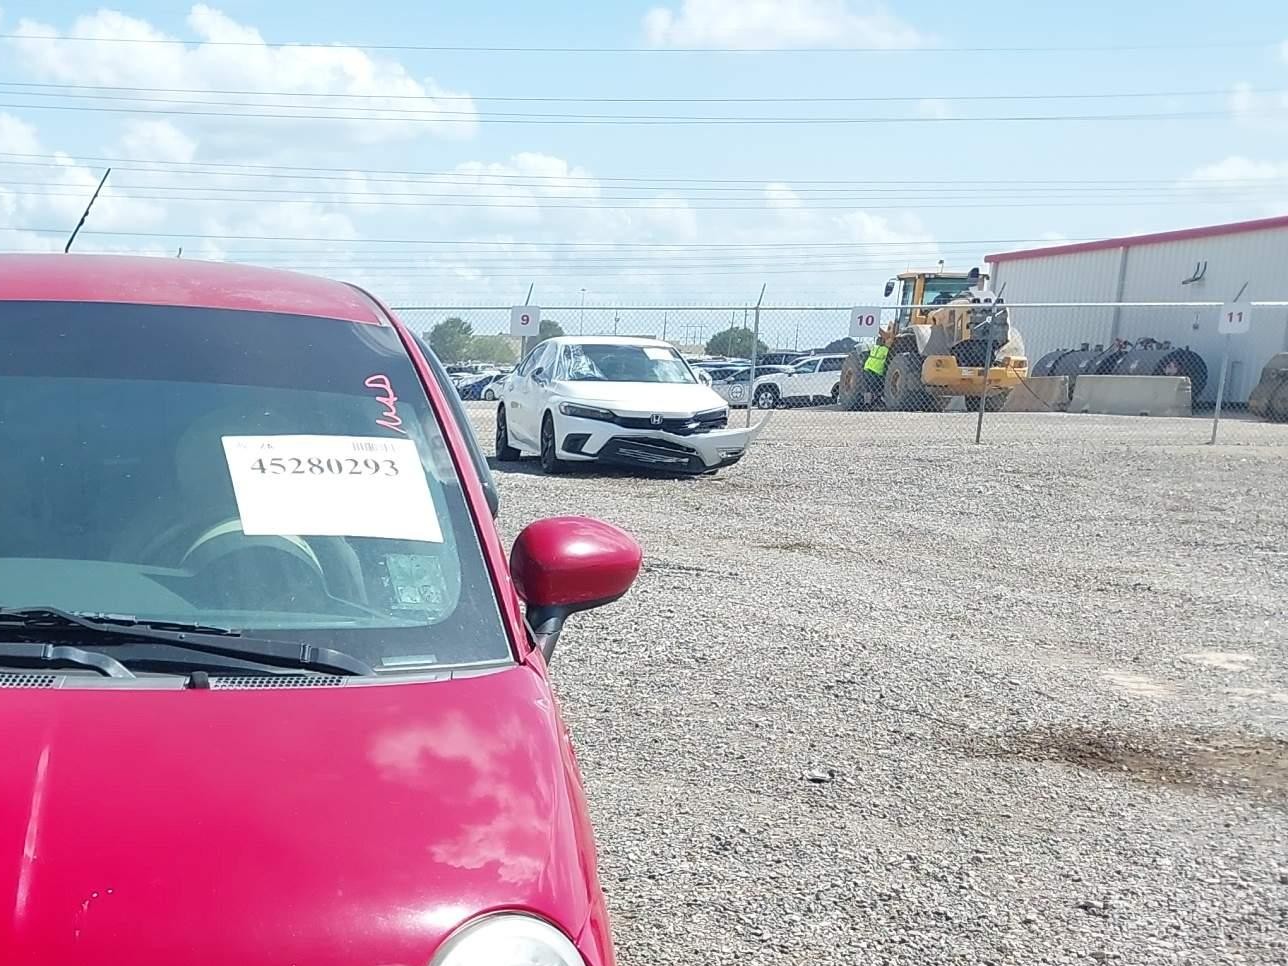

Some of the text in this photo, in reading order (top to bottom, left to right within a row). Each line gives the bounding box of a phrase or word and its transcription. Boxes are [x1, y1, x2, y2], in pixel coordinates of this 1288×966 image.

[520, 314, 530, 326] 9
[857, 315, 875, 326] 10
[1227, 311, 1243, 323] 11
[250, 457, 400, 477] 45280293
